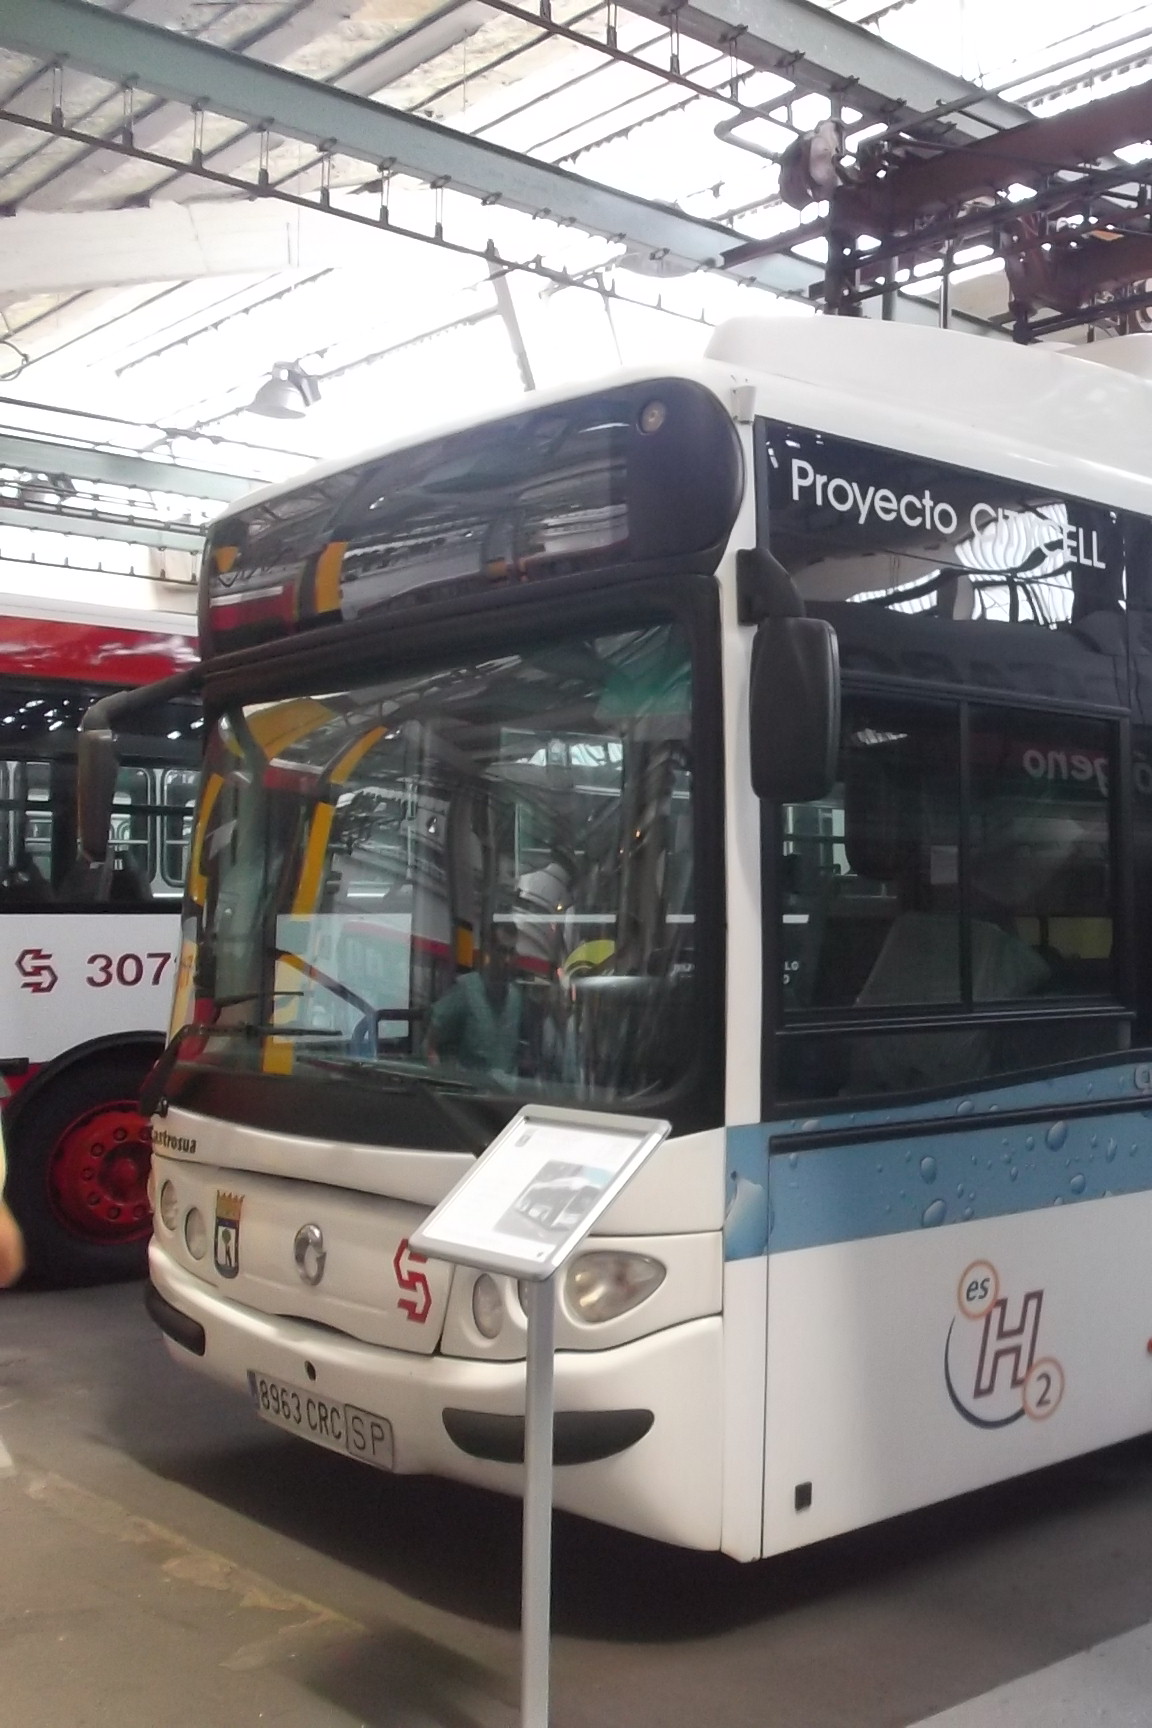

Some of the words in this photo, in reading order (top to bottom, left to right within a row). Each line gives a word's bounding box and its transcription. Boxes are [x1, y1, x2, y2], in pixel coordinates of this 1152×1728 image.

[791, 457, 958, 535] Proyecto
[969, 501, 1106, 569] CITCELL
[85, 951, 178, 988] 307
[965, 1276, 991, 1302] es
[259, 1379, 302, 1426] 8963
[306, 1397, 343, 1440] CRC
[351, 1415, 385, 1456] SP
